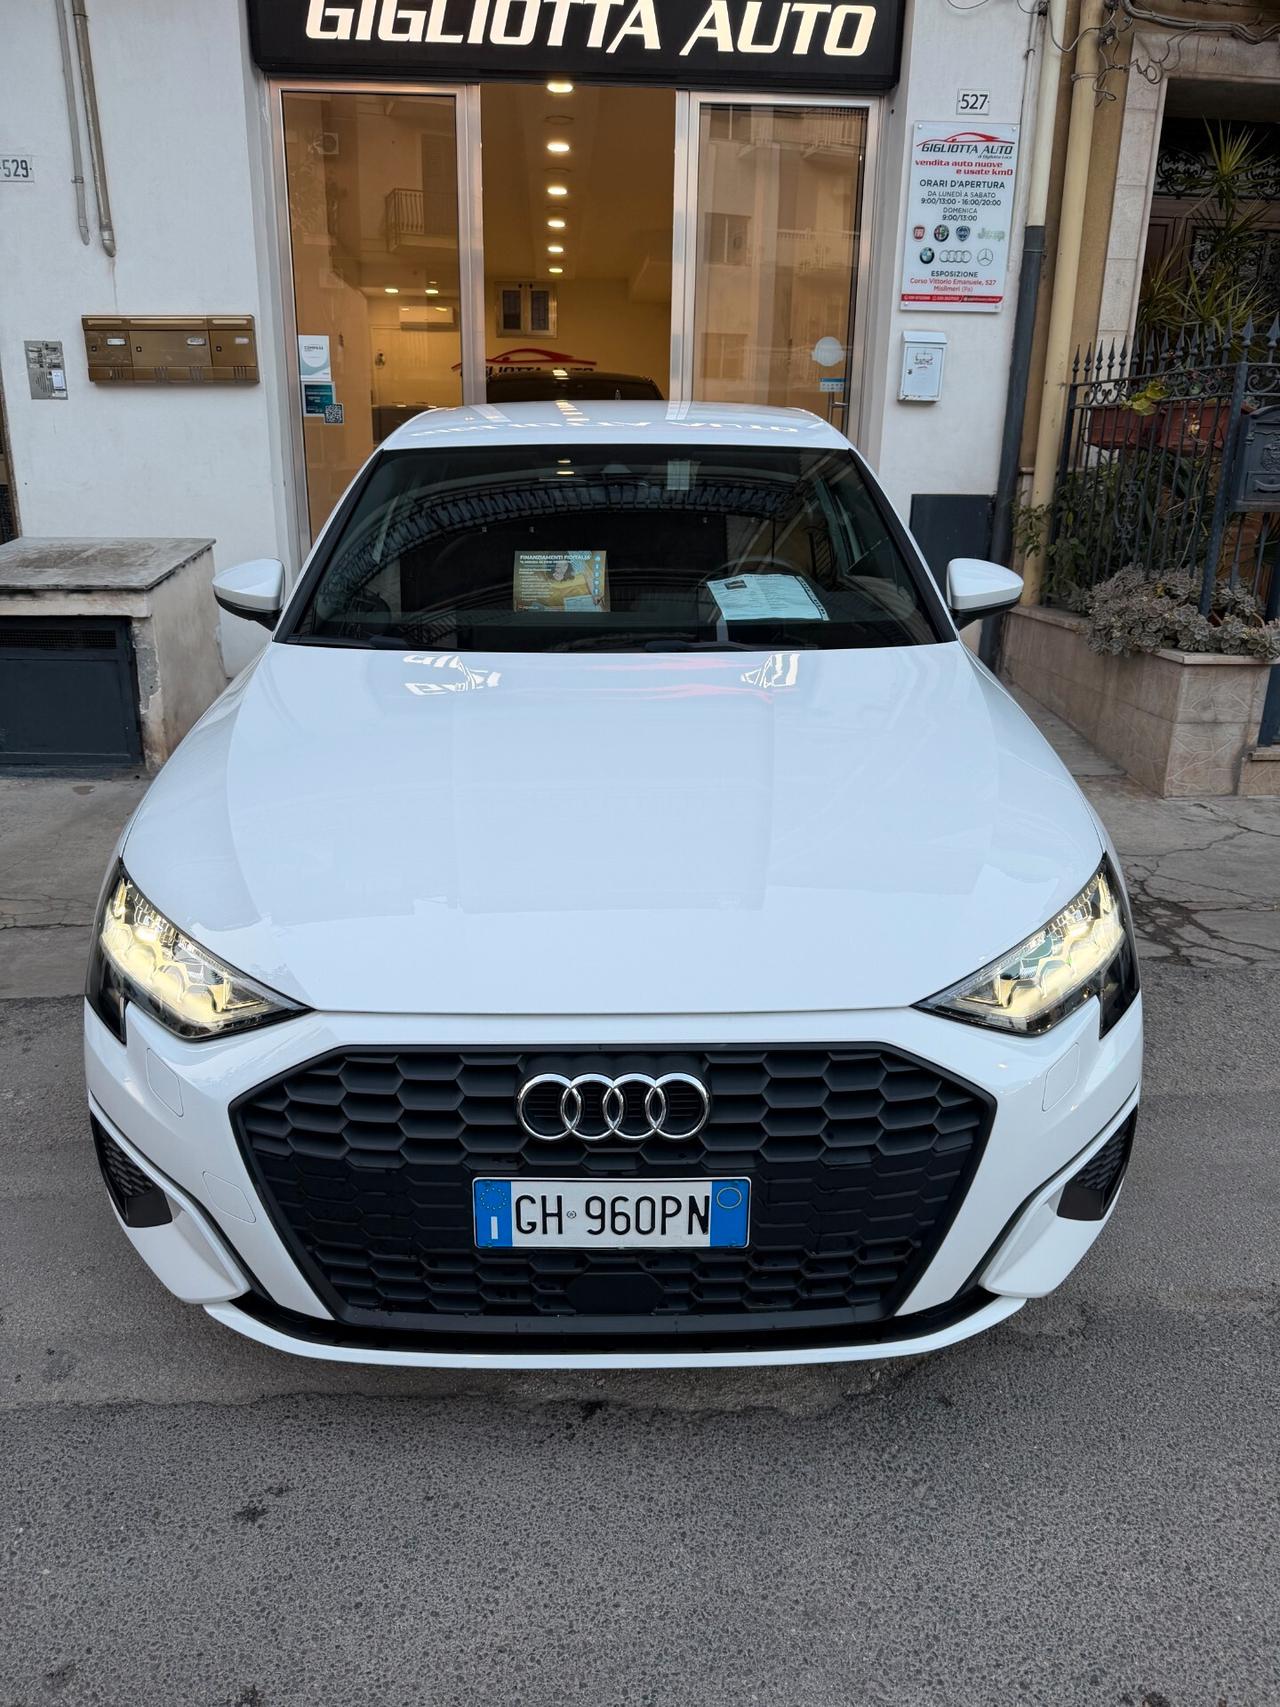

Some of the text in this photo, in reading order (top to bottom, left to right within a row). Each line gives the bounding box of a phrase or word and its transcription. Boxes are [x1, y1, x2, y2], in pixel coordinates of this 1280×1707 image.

[305, 0, 876, 56] GIGLIOTTA AUTO
[960, 94, 989, 110] 527
[921, 143, 1013, 155] GIGLIOTTA AUTO
[2, 159, 29, 178] 529
[915, 159, 950, 167] vendita
[920, 179, 1005, 189] ORARI D'APERTURA
[931, 270, 978, 278] ESPOSIZIONE
[514, 1194, 710, 1236] GH 960PN
